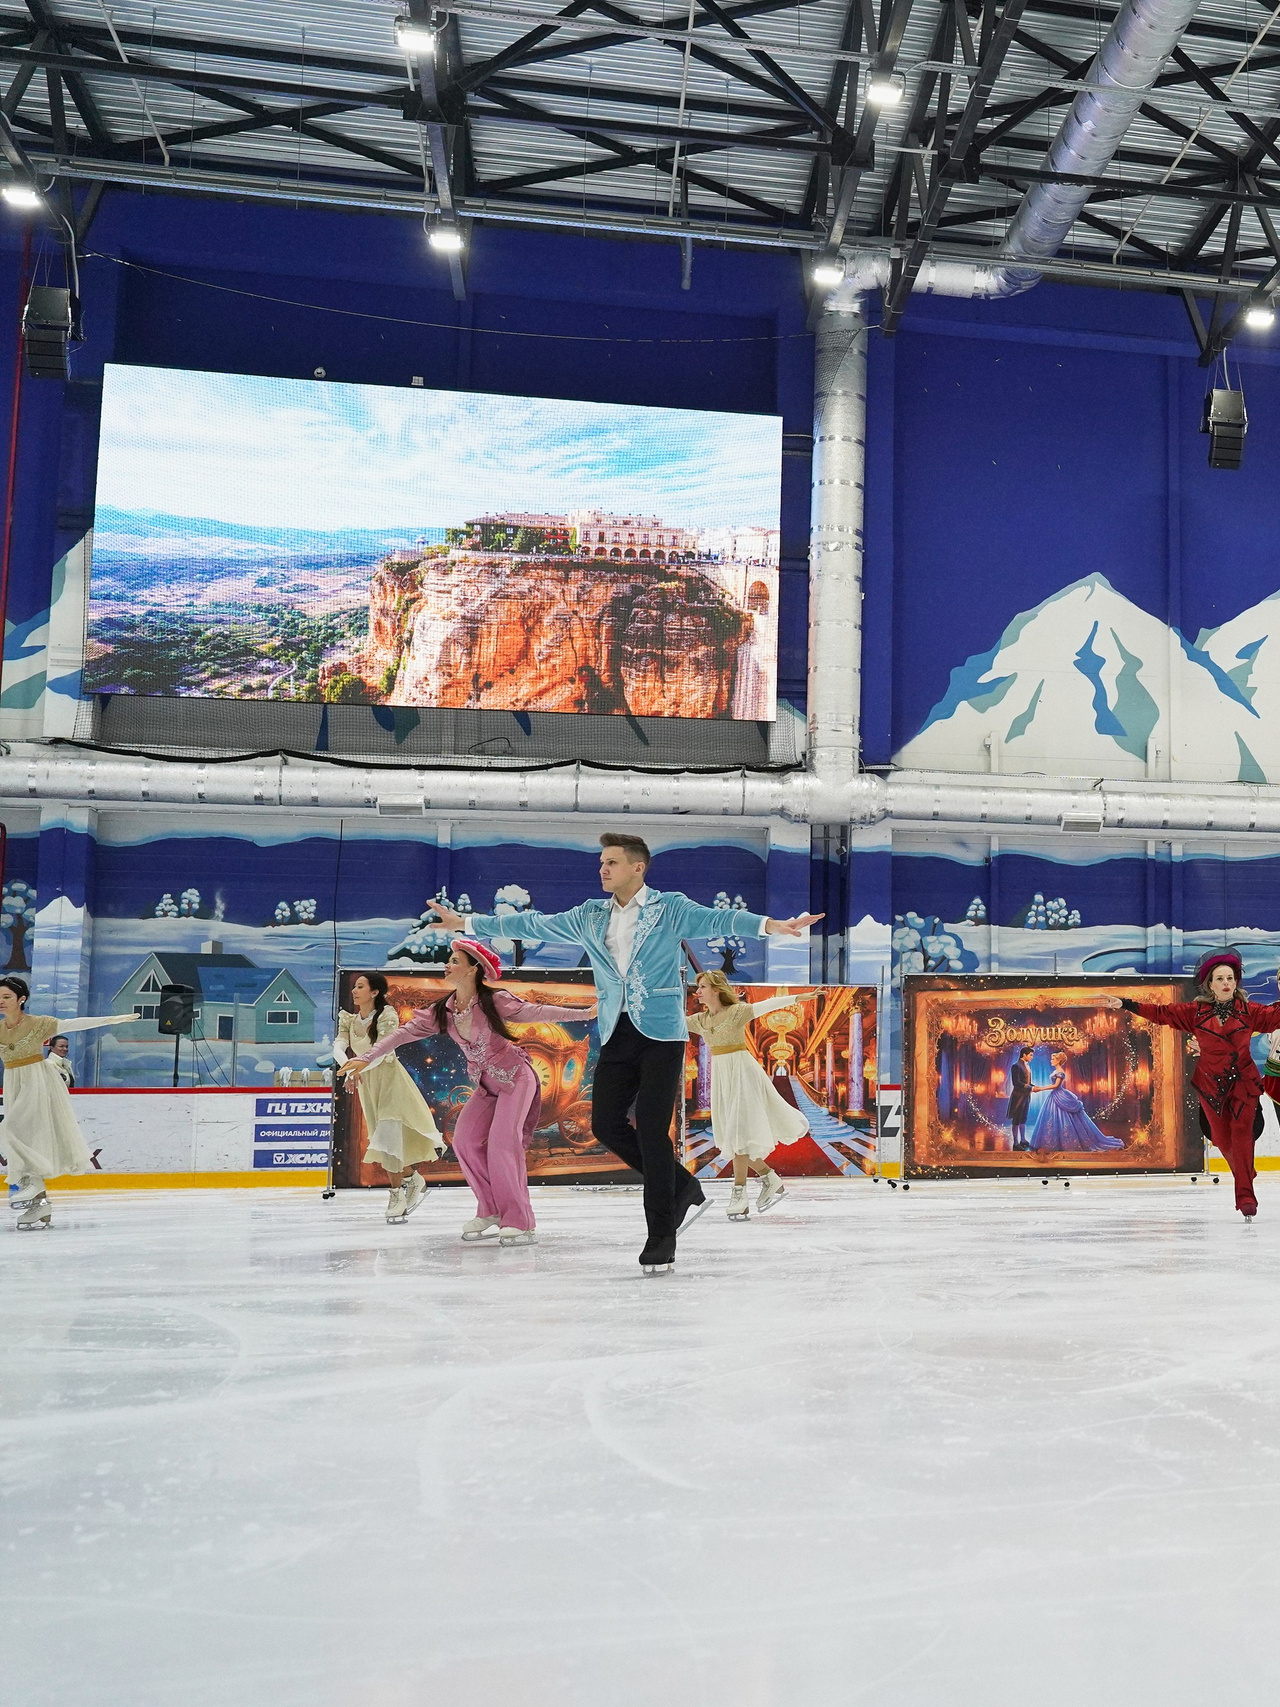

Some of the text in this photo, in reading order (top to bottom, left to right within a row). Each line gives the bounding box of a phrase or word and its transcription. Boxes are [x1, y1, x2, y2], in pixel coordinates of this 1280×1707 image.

[985, 1017, 1079, 1047] Золушка
[266, 1103, 287, 1115] ГЦ
[260, 1129, 318, 1137] ОФИЦИАЛЬНЫЙ
[284, 1153, 328, 1164] XCMG
